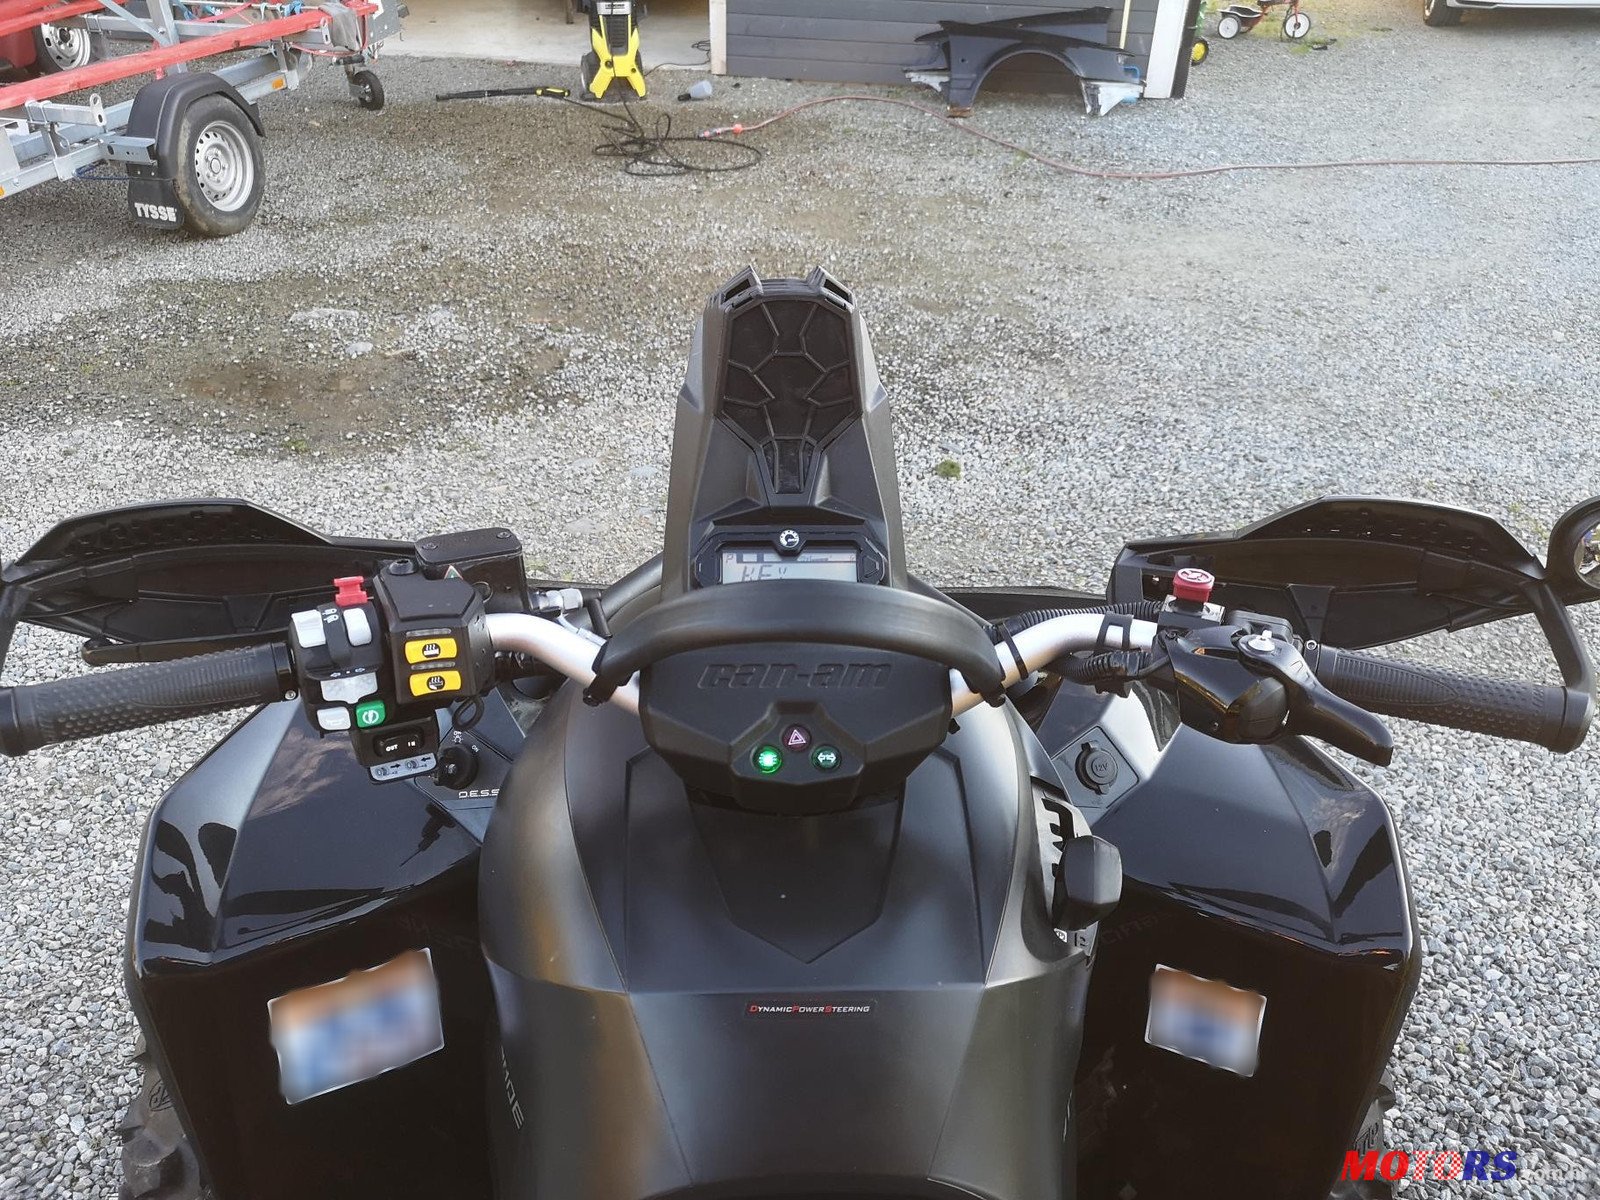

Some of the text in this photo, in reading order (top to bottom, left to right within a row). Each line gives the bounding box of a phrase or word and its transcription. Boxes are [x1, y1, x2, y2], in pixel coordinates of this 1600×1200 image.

[134, 202, 176, 222] TYSSE
[697, 663, 891, 689] can-am
[385, 743, 398, 752] OUT
